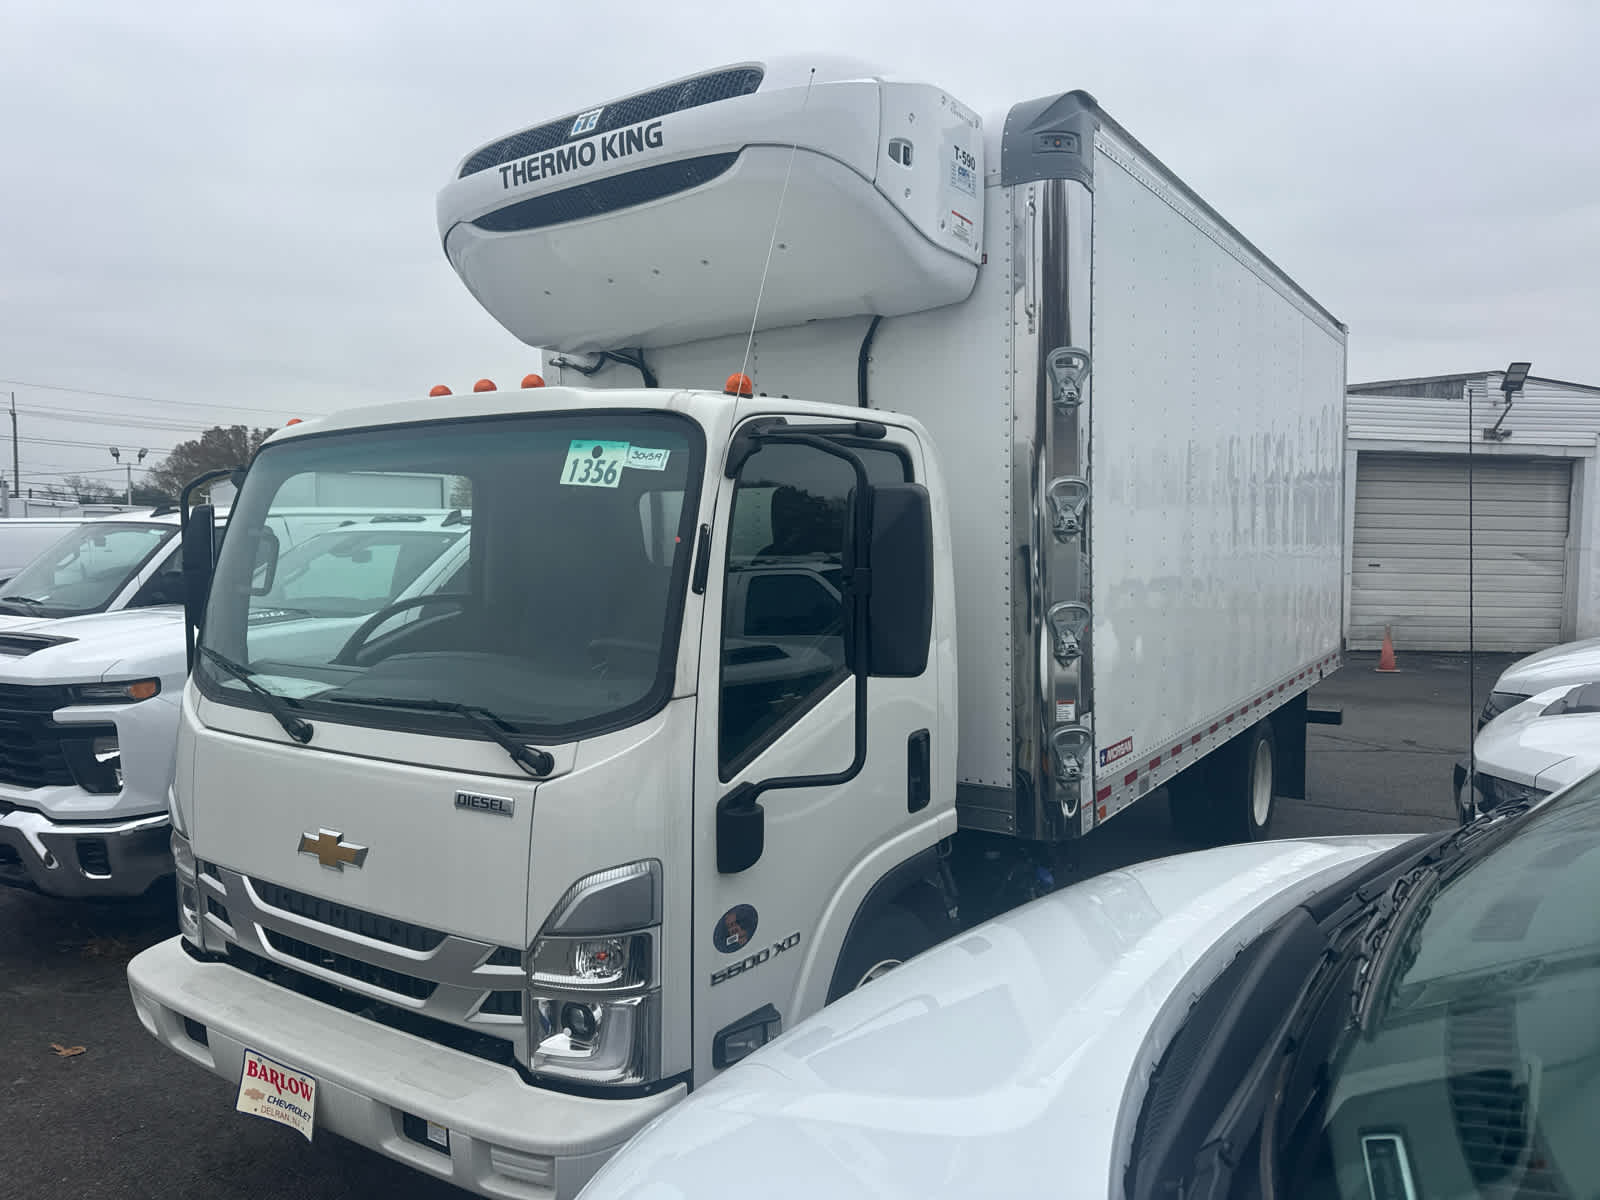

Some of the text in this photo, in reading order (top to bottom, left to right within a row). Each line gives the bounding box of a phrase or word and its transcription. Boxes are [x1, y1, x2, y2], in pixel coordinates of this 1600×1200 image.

[499, 121, 663, 189] THERMO KING
[954, 145, 976, 171] T-590
[569, 458, 618, 485] 1356
[457, 793, 507, 812] DIESEL
[710, 931, 801, 987] 5500 XD
[247, 1059, 314, 1102] BARLOW
[266, 1095, 312, 1122] CHEVROLET
